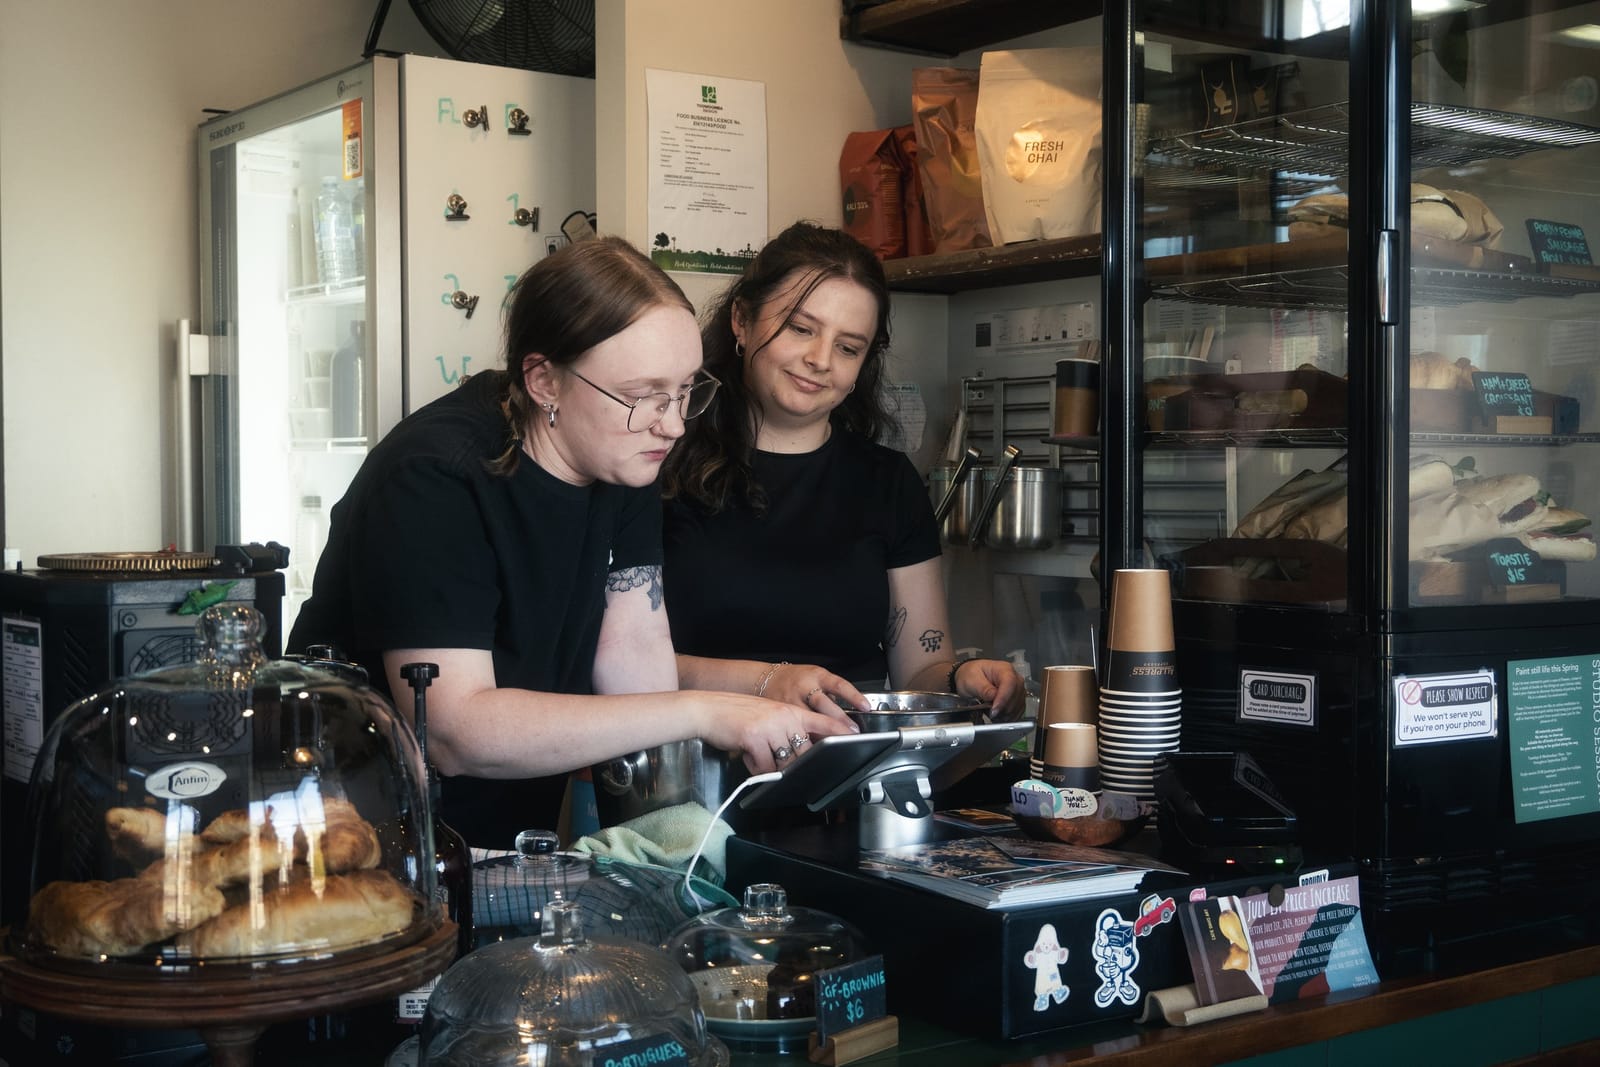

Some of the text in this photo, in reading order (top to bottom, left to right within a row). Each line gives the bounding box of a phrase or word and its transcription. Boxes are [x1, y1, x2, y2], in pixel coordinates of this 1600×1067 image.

[208, 121, 246, 142] SKOPE
[1024, 140, 1064, 152] FRESH
[1027, 152, 1058, 164] CHAI
[1490, 552, 1532, 567] TOASTIE
[1507, 567, 1526, 584] $15
[1515, 663, 1579, 676] Paint still life this Spring
[1253, 682, 1304, 700] CARD SURCHARGE
[1426, 686, 1488, 704] PLEASE SHOW RESPECT
[1413, 710, 1482, 722] We won't serve you
[1403, 725, 1410, 733] if
[1410, 724, 1434, 735] you're
[1445, 722, 1462, 732] your
[1463, 719, 1487, 730] phone.
[1063, 795, 1086, 803] THANK
[1067, 801, 1081, 809] YOU
[1247, 899, 1267, 922] JULY
[1284, 892, 1307, 913] PRICE
[1310, 884, 1351, 907] INCREASE
[1326, 910, 1337, 920] PRICE
[1337, 906, 1355, 918] INCREASE
[825, 970, 886, 999] GF-BROWNIE
[846, 998, 865, 1024] $6
